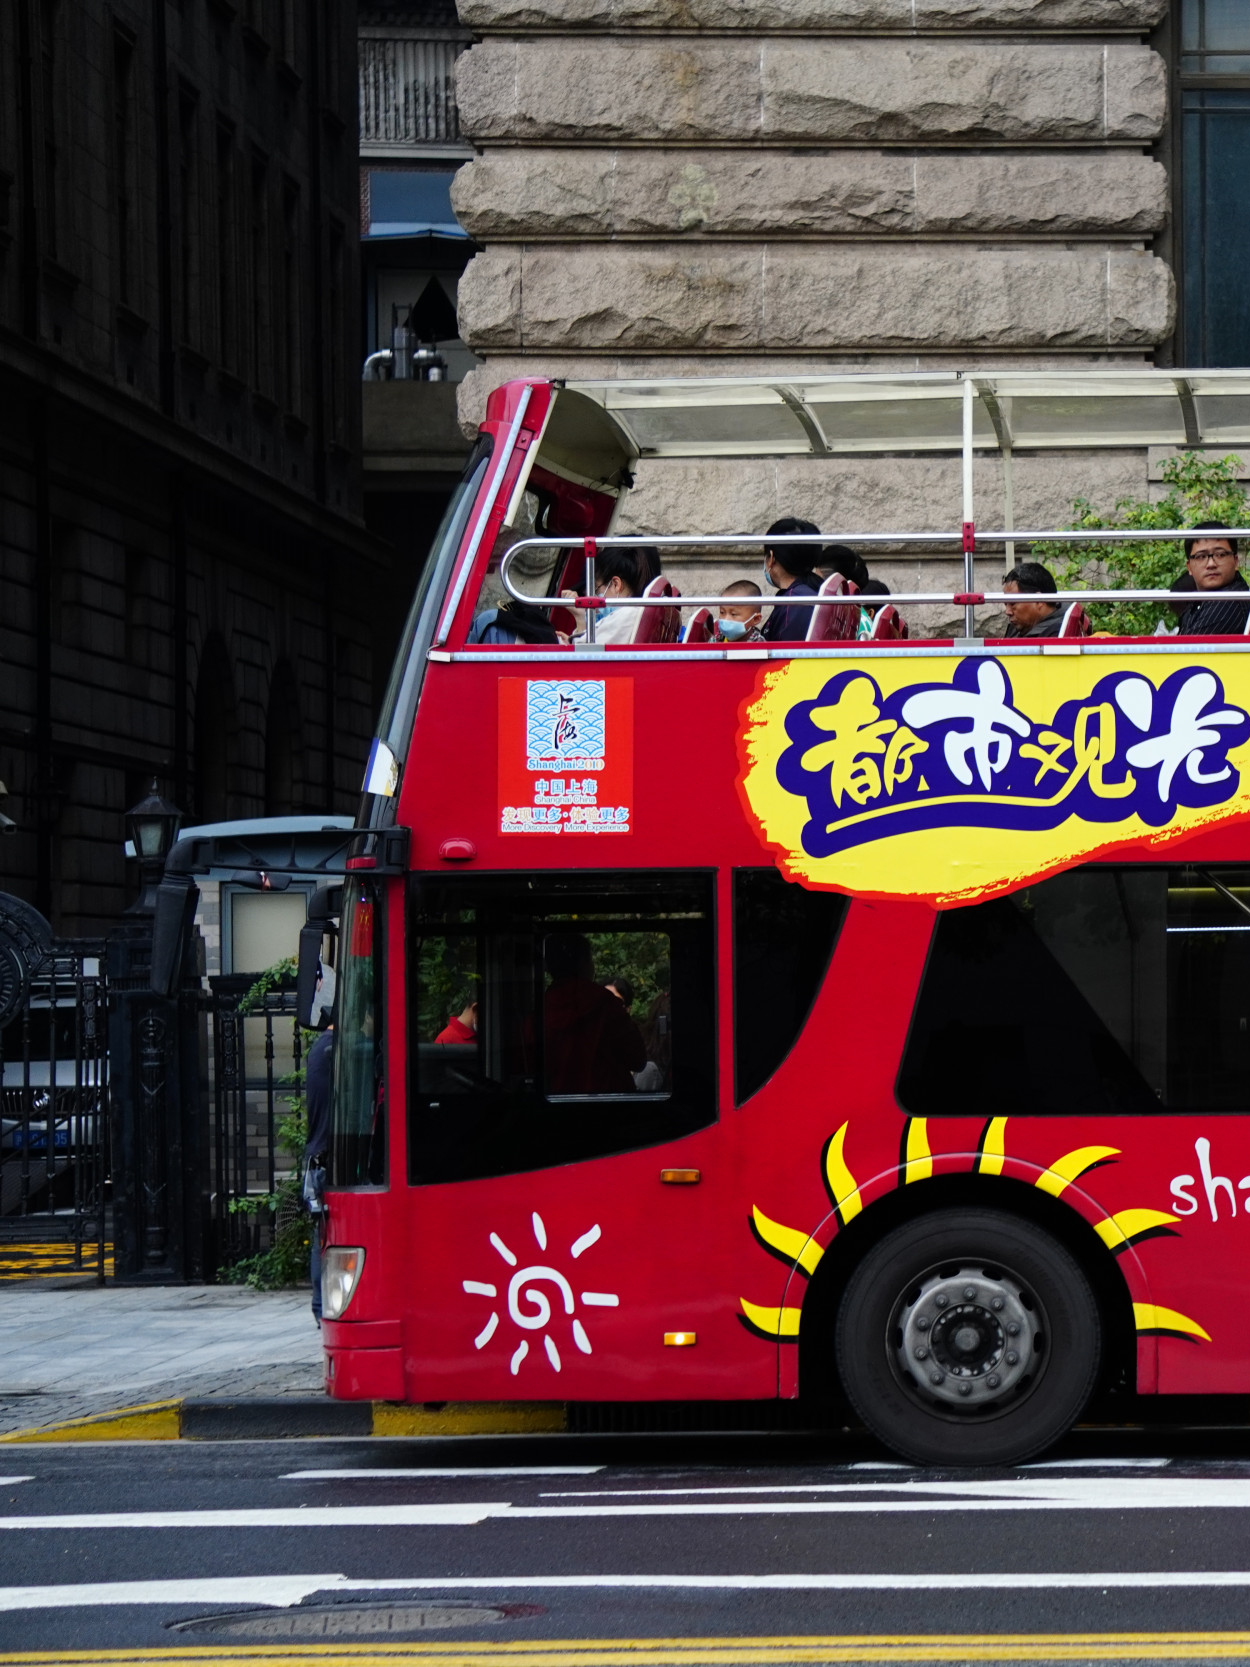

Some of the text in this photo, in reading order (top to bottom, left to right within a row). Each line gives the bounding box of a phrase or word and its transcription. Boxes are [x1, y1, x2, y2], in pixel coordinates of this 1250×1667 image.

[797, 657, 1248, 810] 都市观光
[527, 758, 604, 771] Shanghai 2010
[535, 778, 598, 794] 中国上海
[535, 795, 596, 805] Shanghai China
[502, 823, 629, 833] More Discovery More Experience
